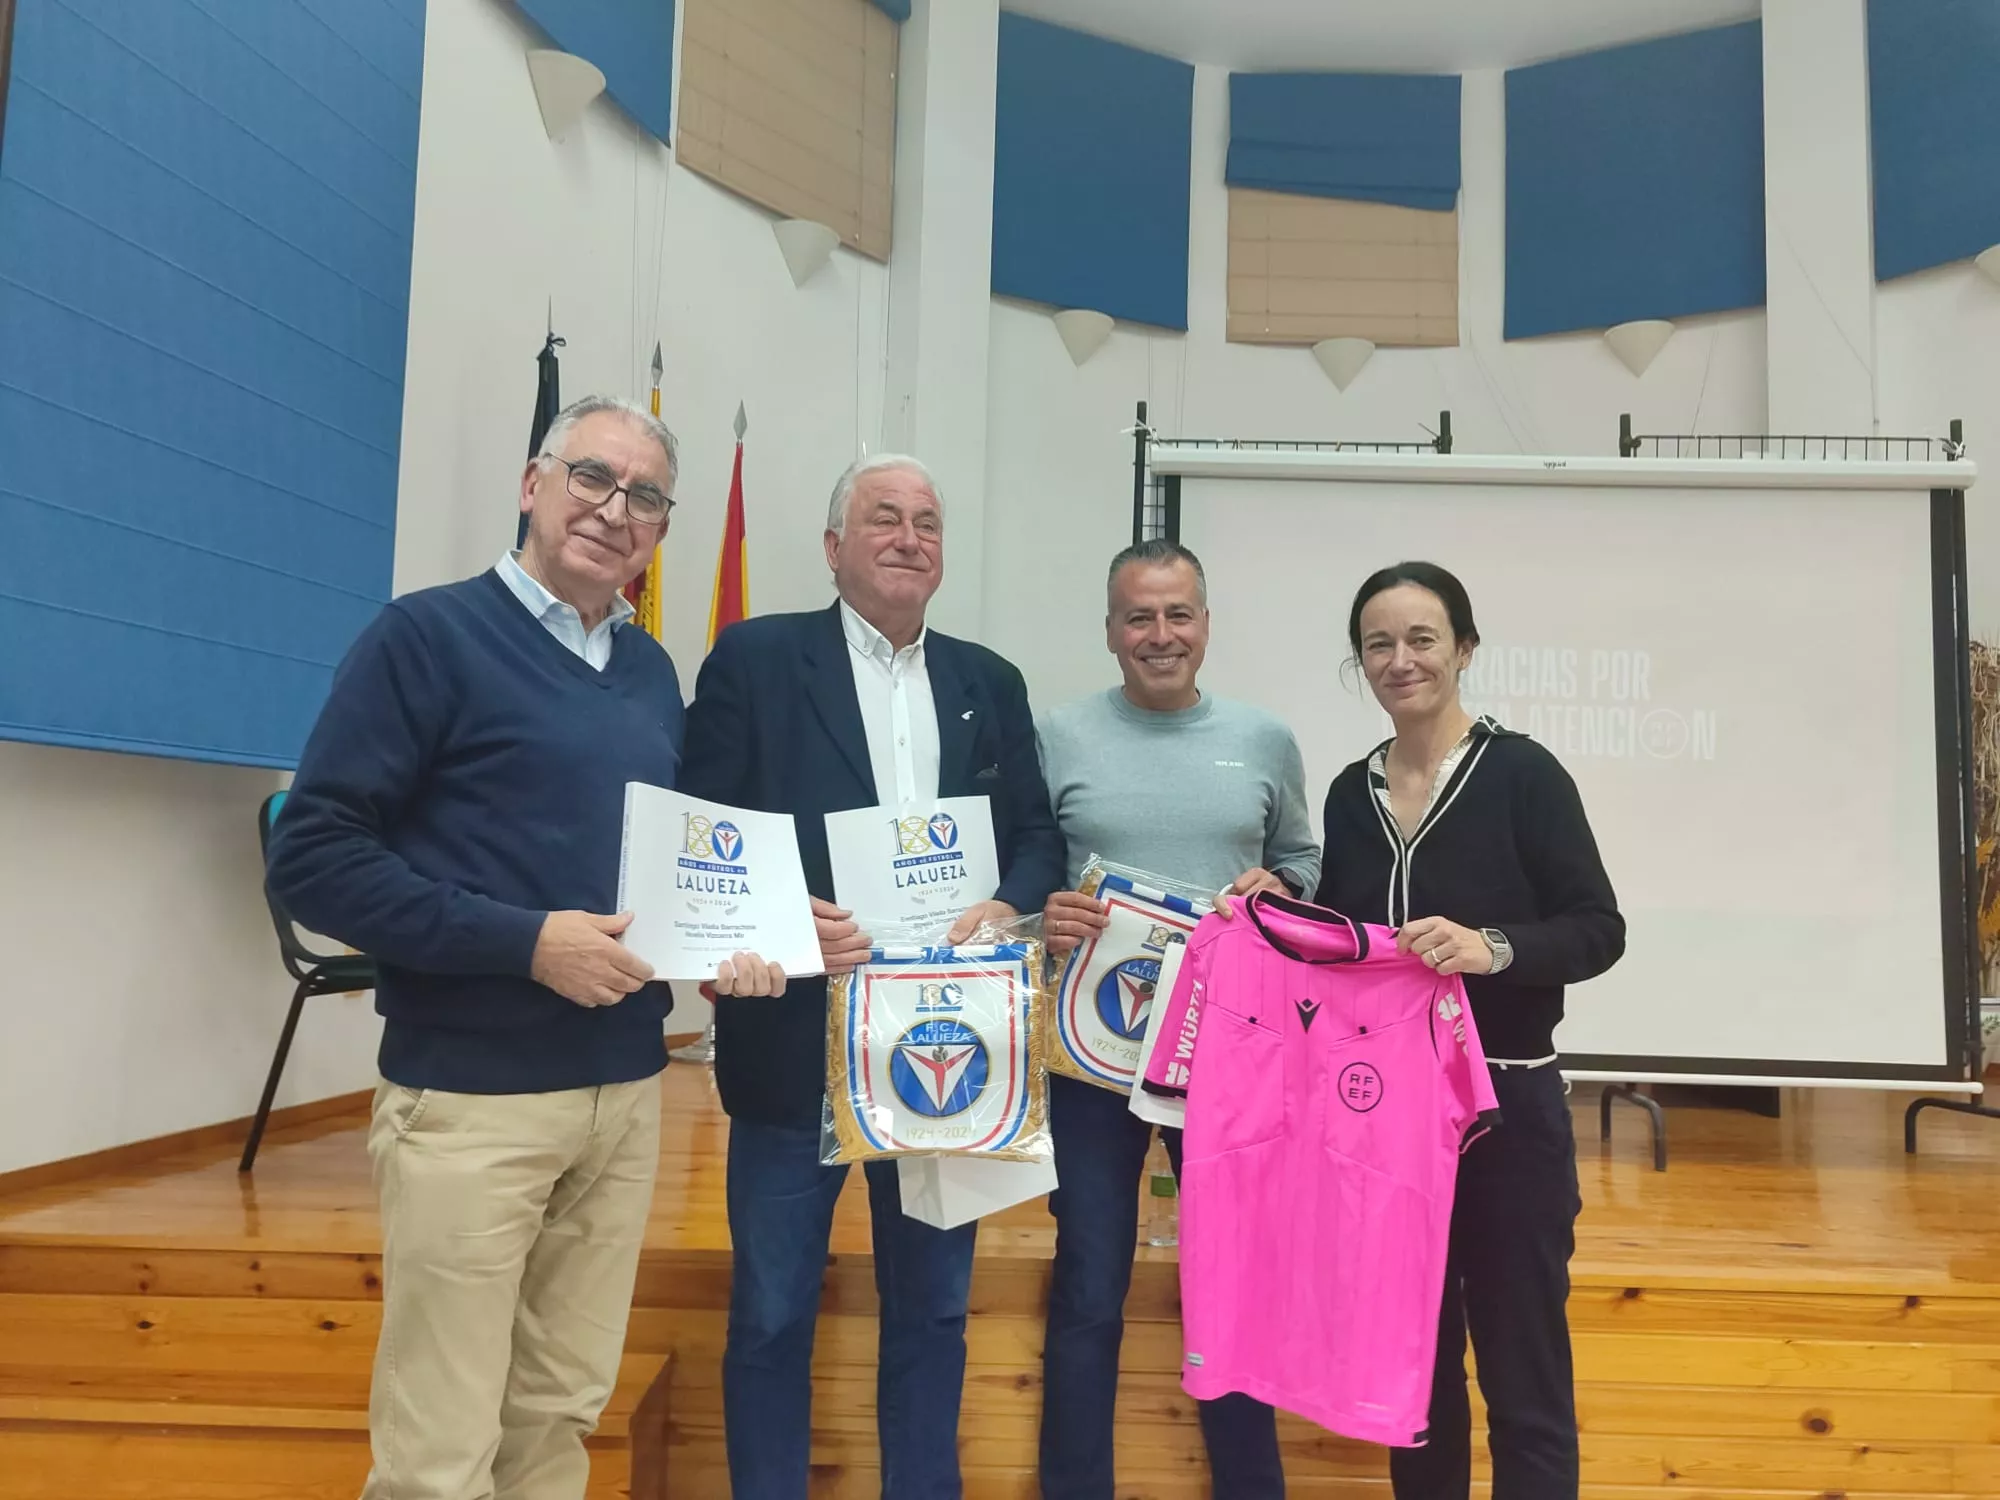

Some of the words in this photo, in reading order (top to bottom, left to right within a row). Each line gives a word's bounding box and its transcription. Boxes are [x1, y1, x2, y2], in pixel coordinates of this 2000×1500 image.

[1461, 645, 1578, 699] RACIAS
[1591, 649, 1651, 701] POR
[676, 872, 752, 895] LALUEZA
[895, 864, 968, 888] LALUEZA
[1126, 963, 1160, 981] LALU
